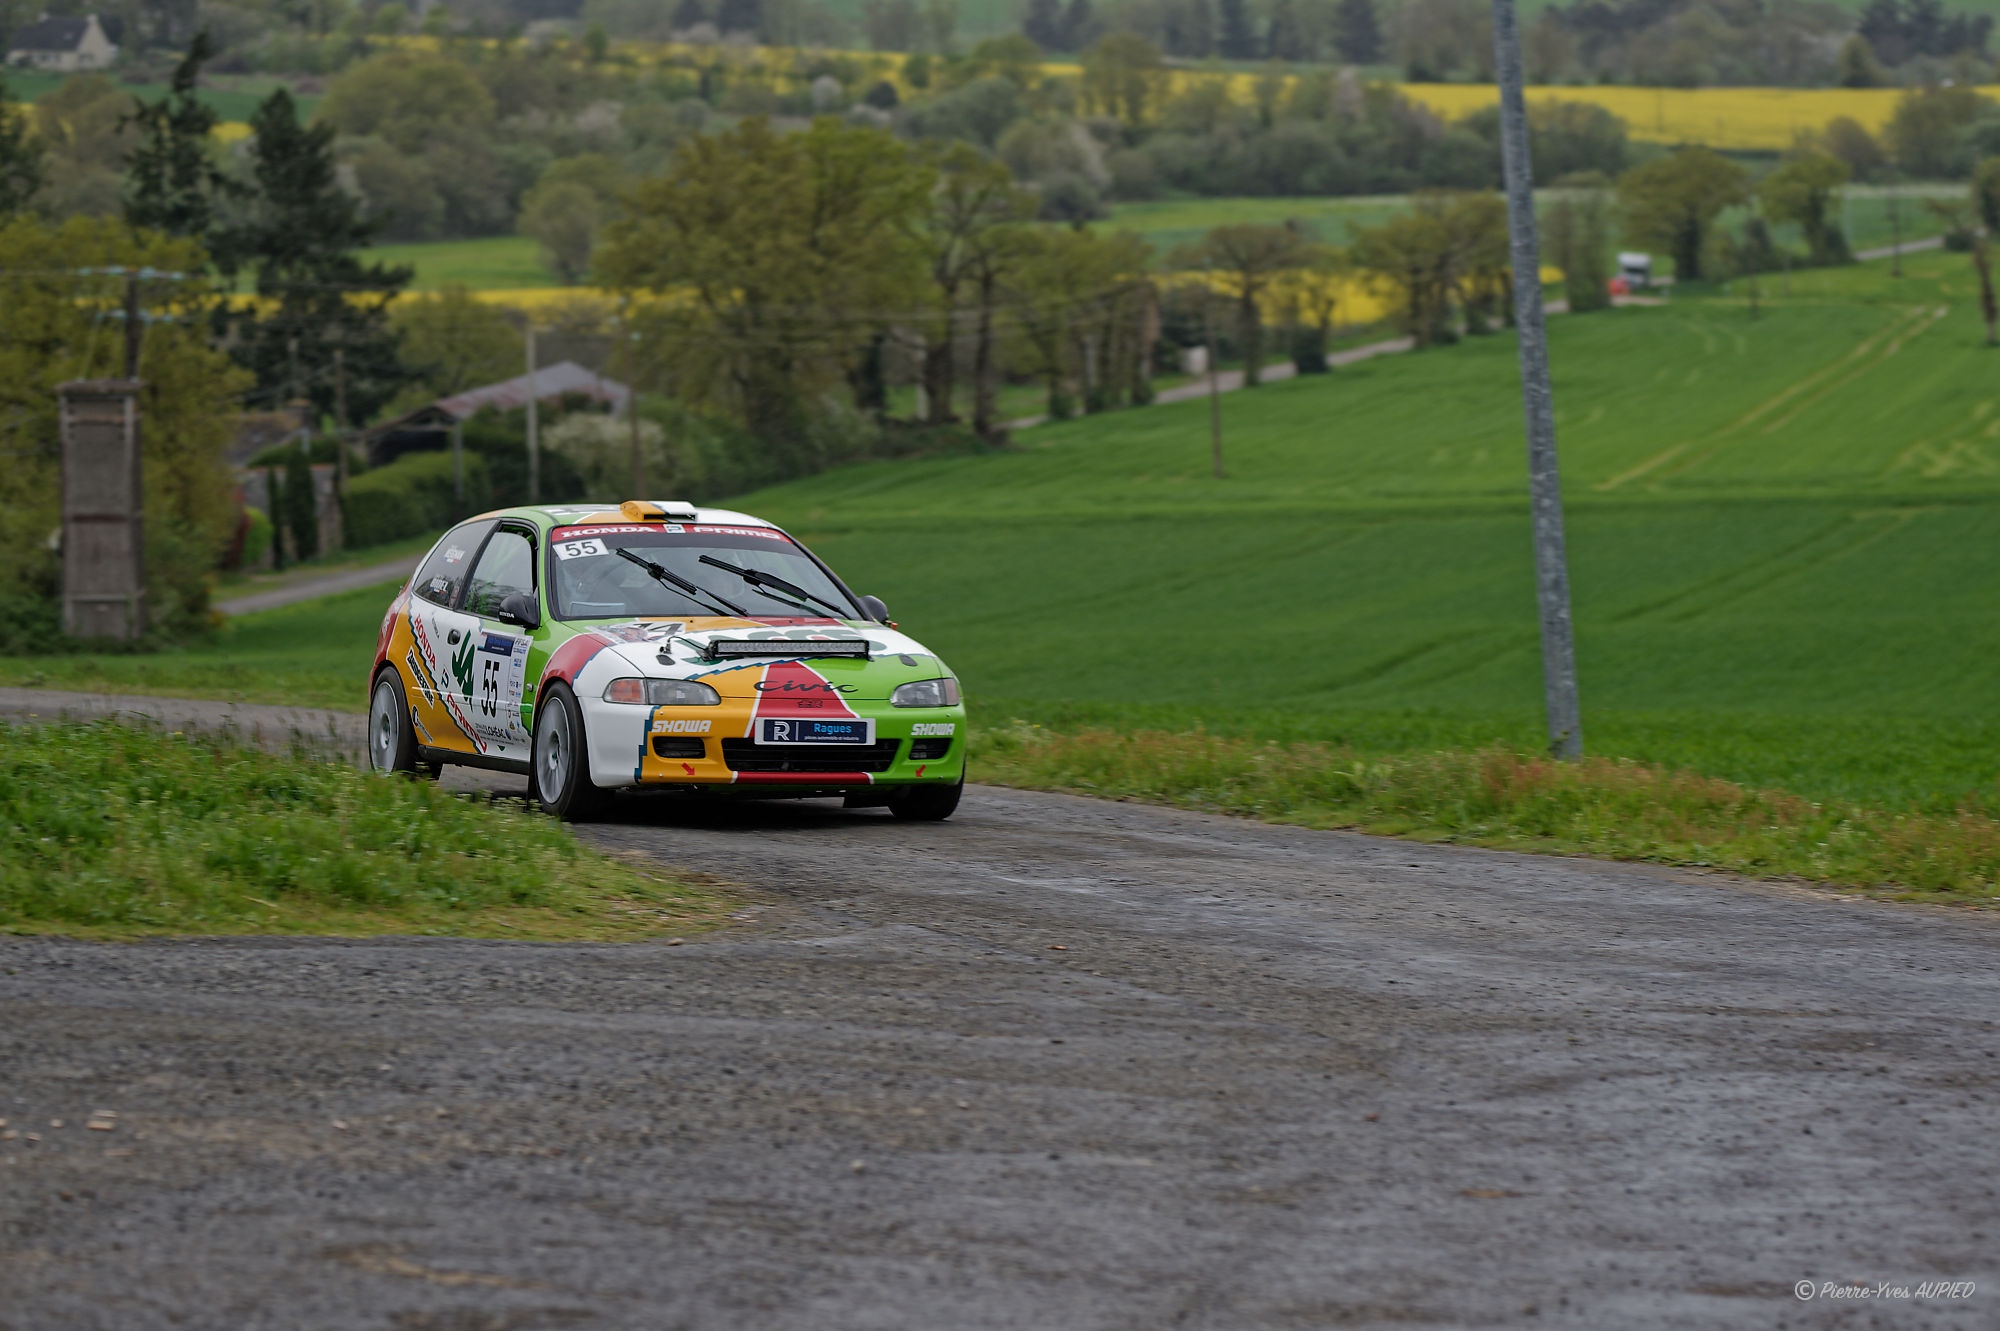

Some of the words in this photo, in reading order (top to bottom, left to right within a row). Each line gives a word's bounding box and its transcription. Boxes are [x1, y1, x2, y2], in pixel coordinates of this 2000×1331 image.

[562, 526, 657, 538] HONDA
[565, 541, 598, 557] 55
[414, 614, 436, 671] HONDA
[481, 659, 500, 718] 55
[753, 680, 859, 693] Civic
[651, 720, 712, 733] SHOWA
[814, 723, 852, 735] Ragues
[910, 723, 955, 736] SHOWA
